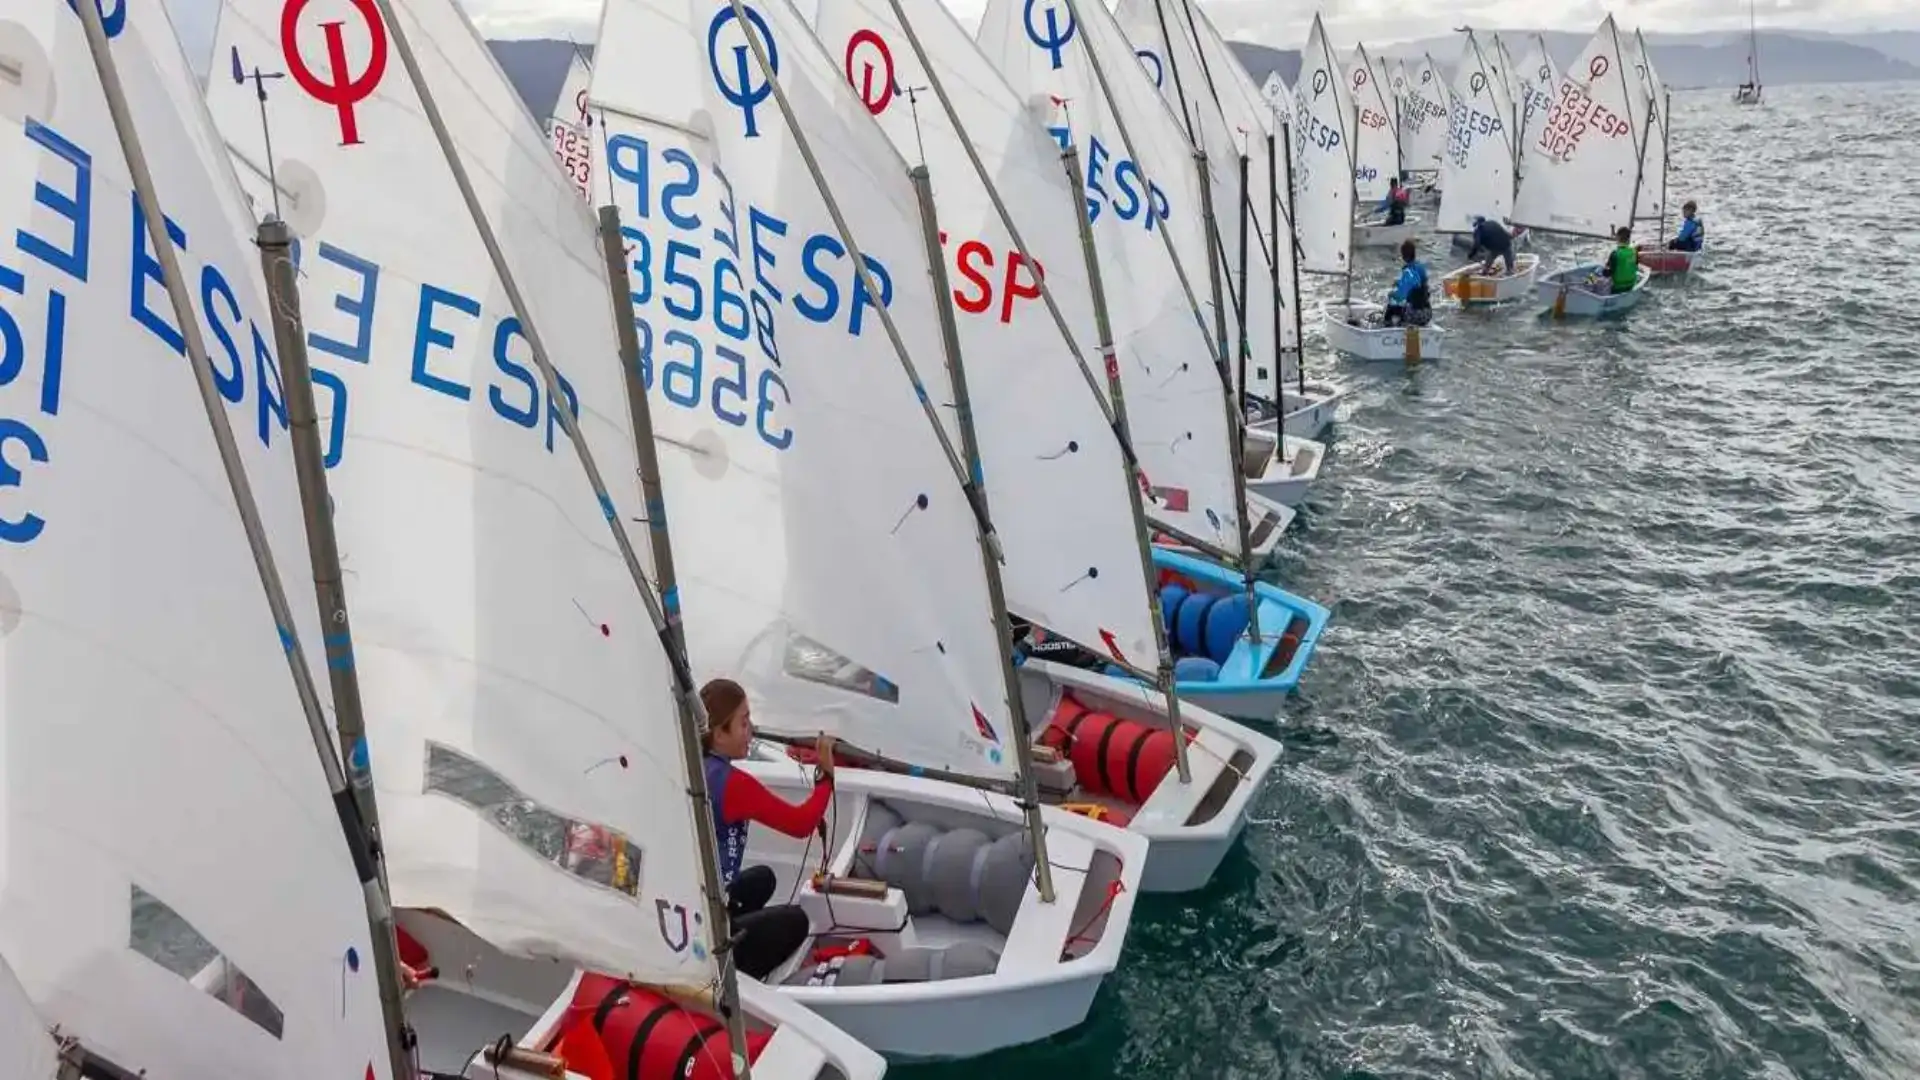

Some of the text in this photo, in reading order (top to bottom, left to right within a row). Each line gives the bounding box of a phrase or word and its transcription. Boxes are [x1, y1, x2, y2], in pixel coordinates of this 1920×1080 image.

[1309, 116, 1340, 152] ESP
[1361, 109, 1387, 131] ESP
[1469, 109, 1502, 136] ESP
[1590, 105, 1629, 138] ESP
[1086, 134, 1170, 232] ESP
[749, 204, 893, 337] ESP
[939, 231, 1045, 323] SP
[131, 189, 289, 449] ESP
[410, 282, 579, 454] ESP
